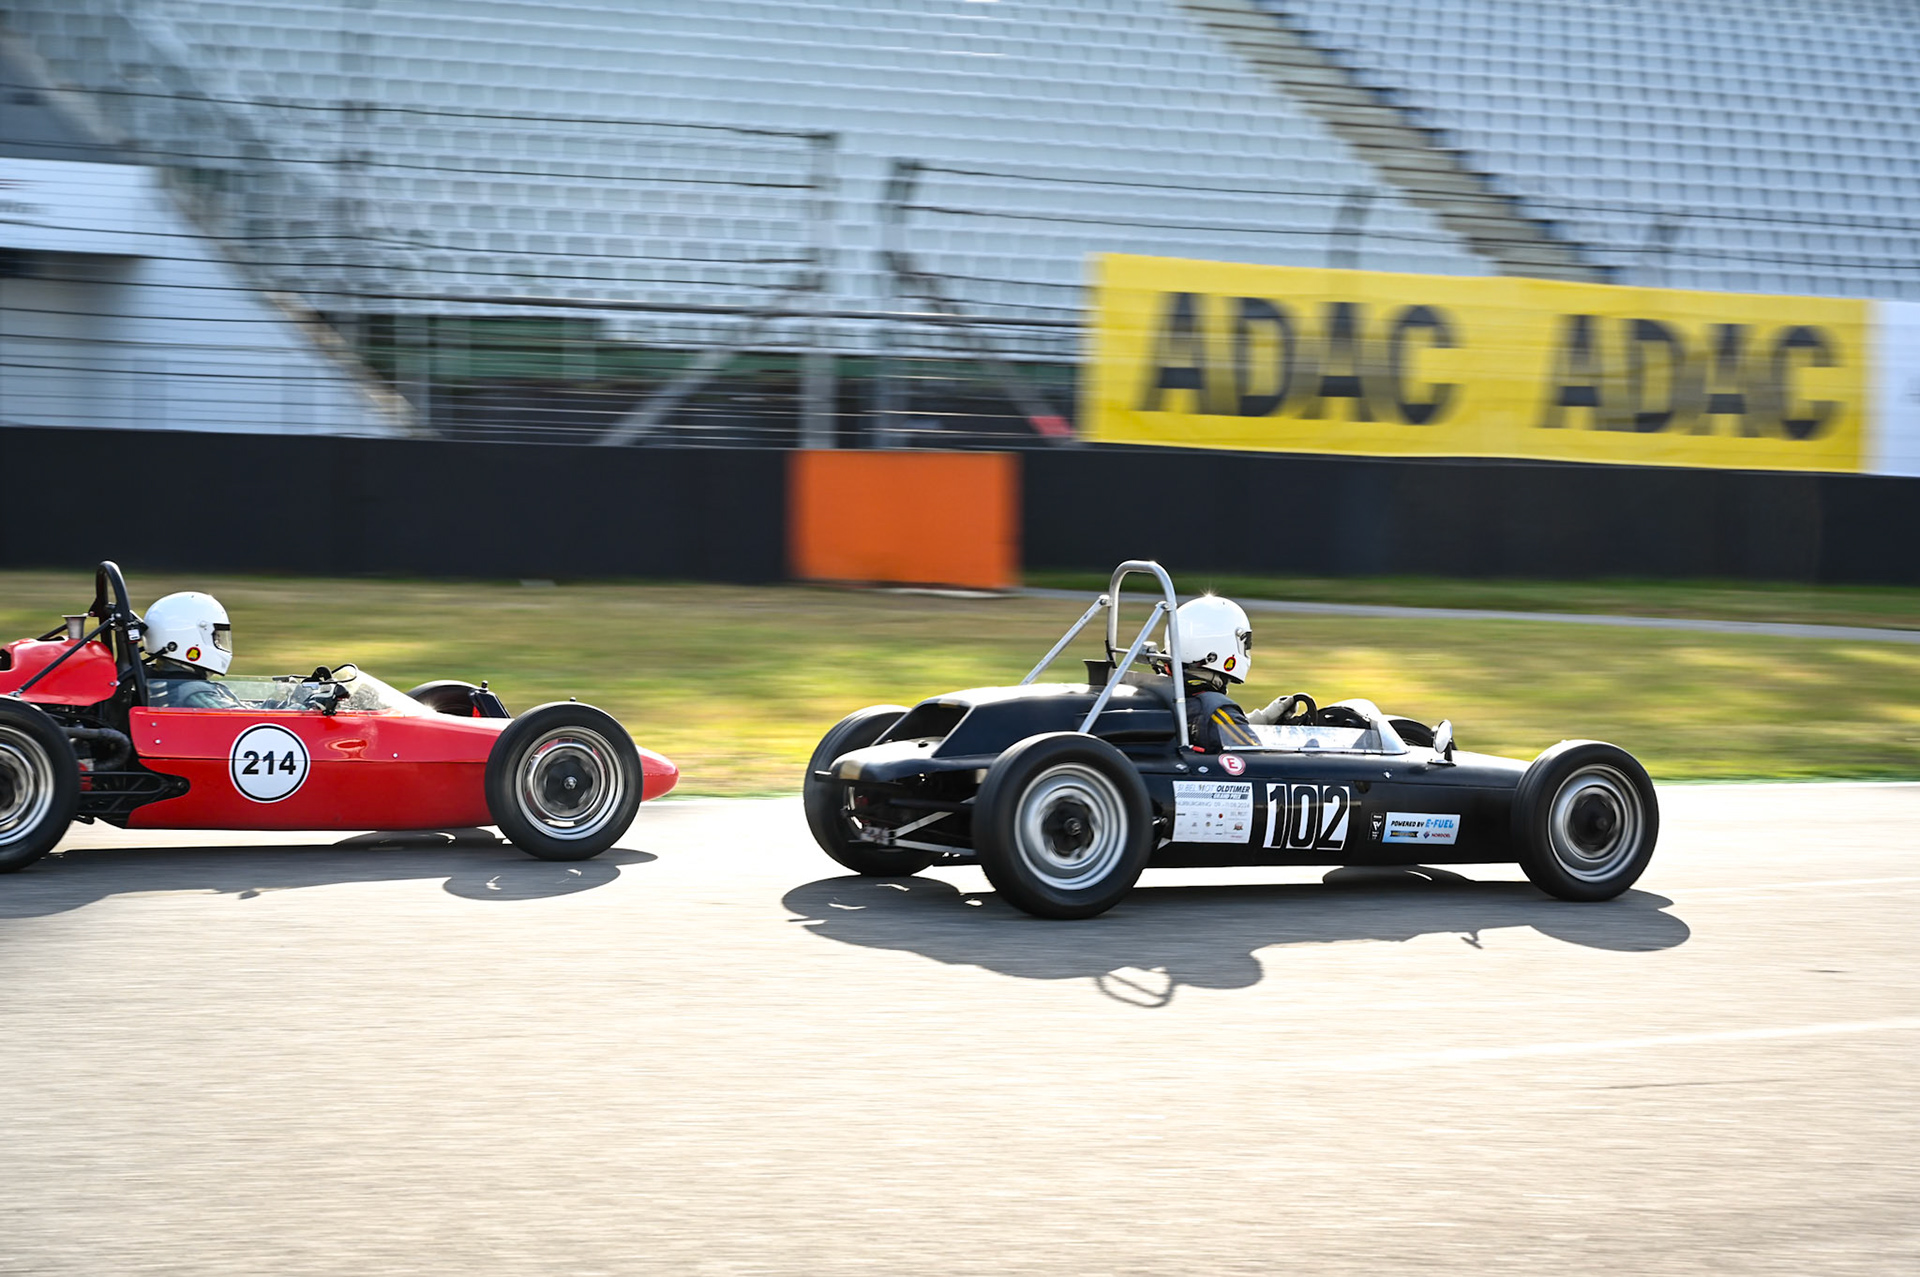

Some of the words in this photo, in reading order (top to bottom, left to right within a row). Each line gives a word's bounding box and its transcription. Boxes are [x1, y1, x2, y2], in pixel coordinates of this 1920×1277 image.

[1136, 291, 1463, 426] ADAC
[1537, 314, 1844, 440] ADAC
[242, 750, 296, 775] 214
[1226, 758, 1239, 769] E
[1216, 785, 1251, 793] OLDTIMER
[1267, 785, 1349, 849] 102
[1425, 818, 1454, 828] E-FUEL
